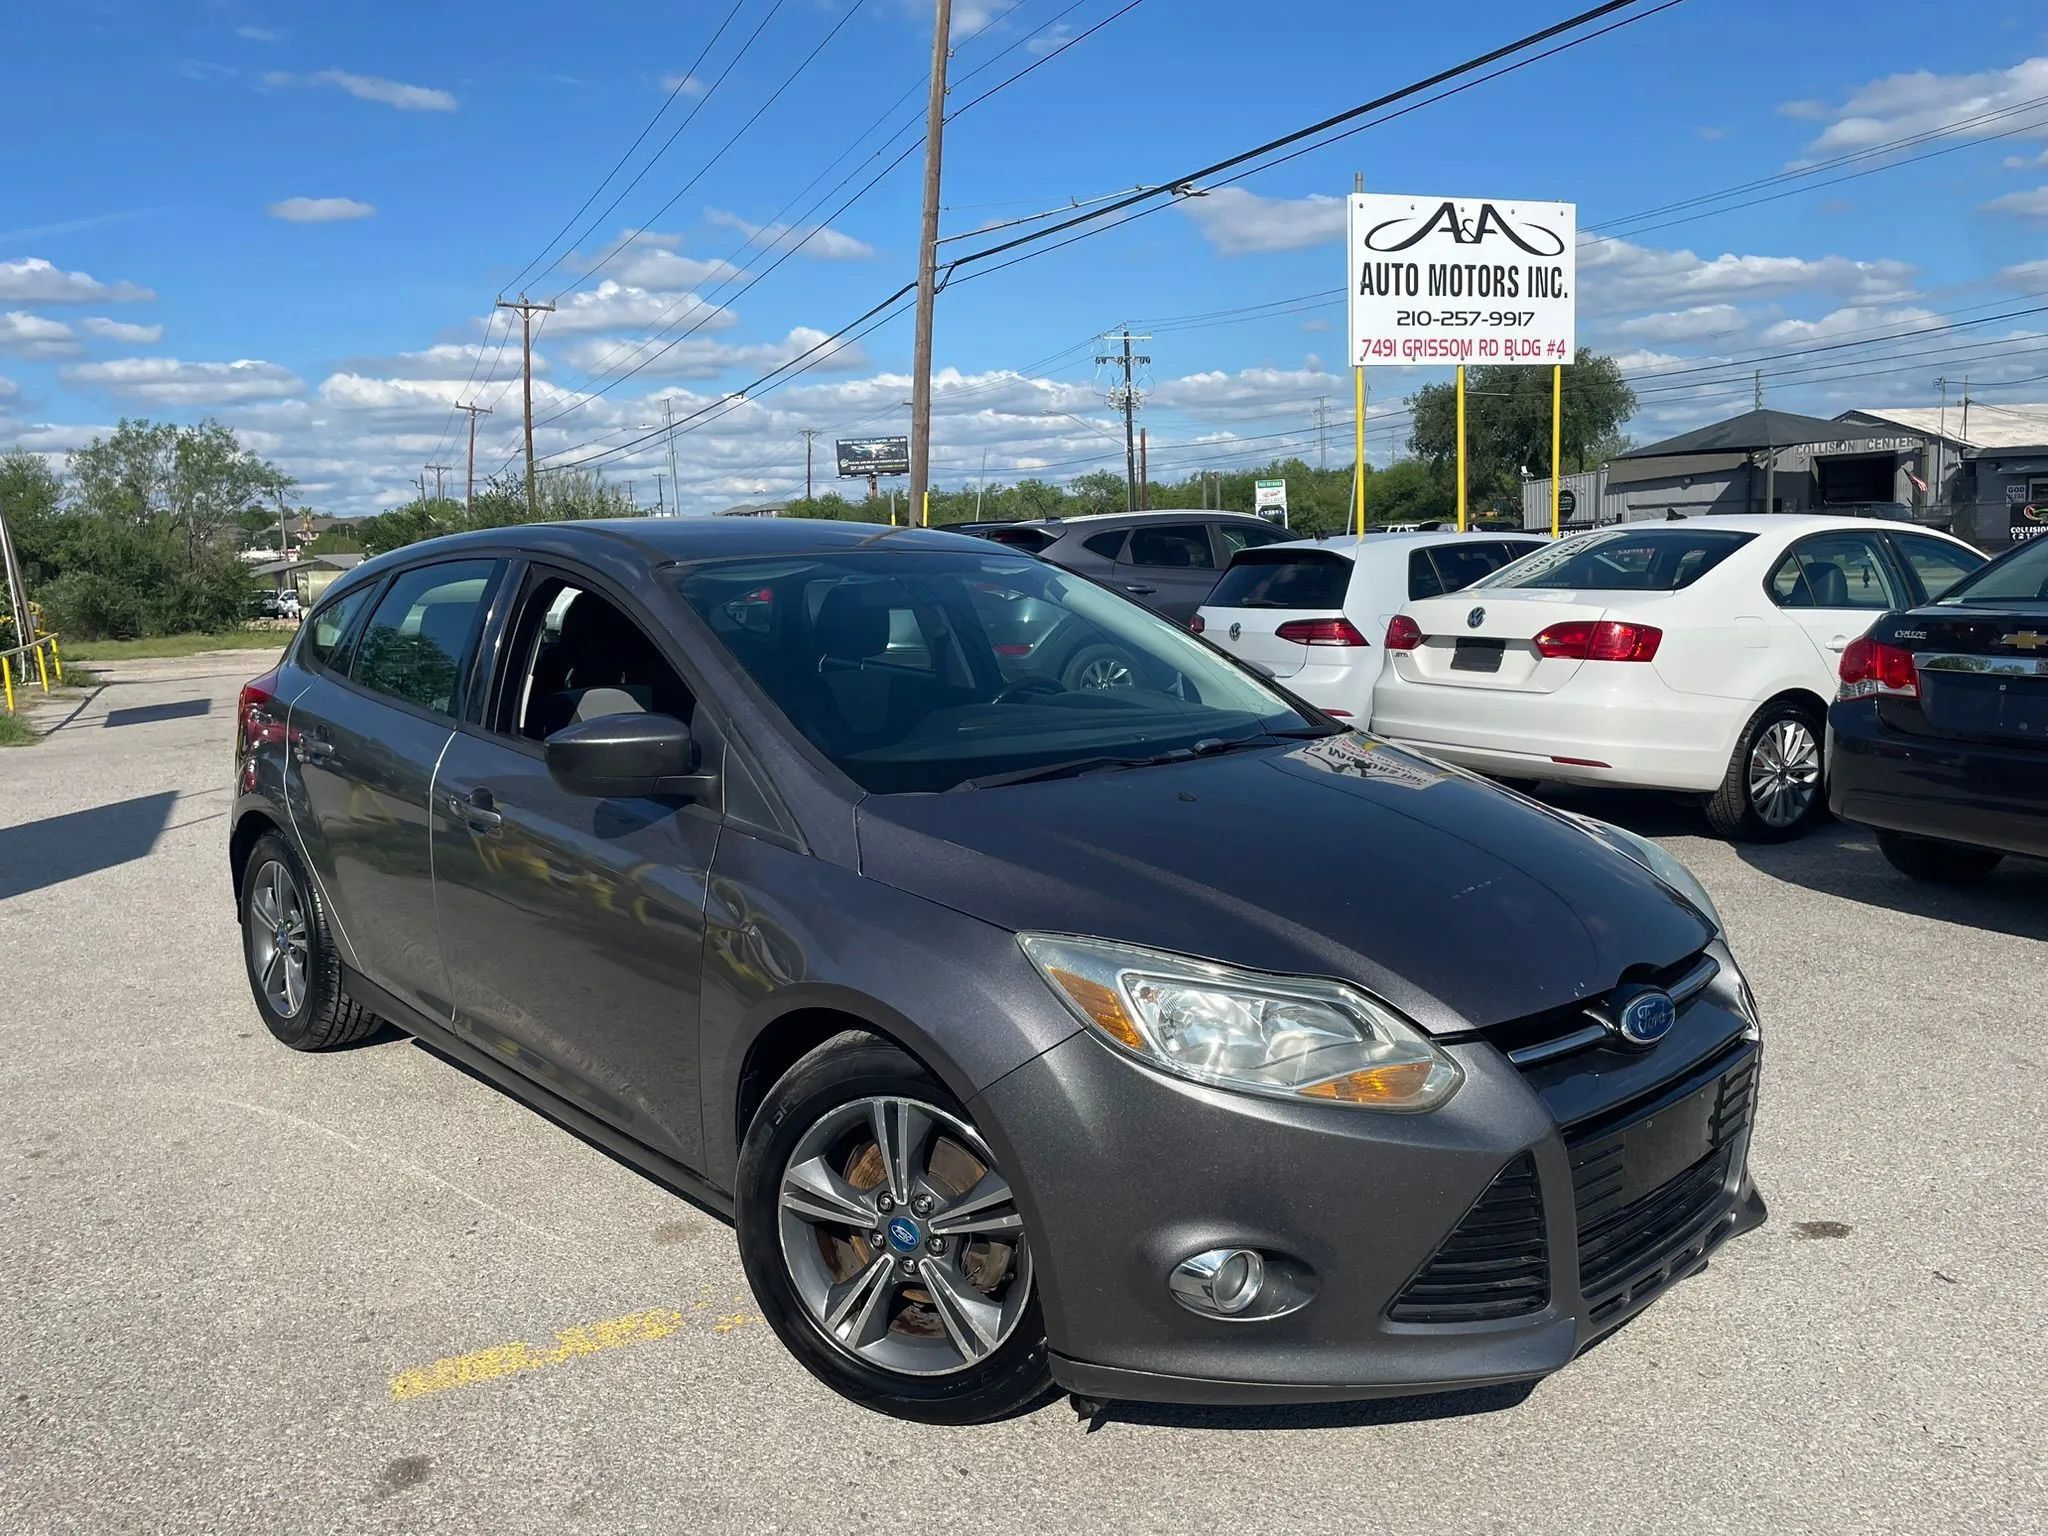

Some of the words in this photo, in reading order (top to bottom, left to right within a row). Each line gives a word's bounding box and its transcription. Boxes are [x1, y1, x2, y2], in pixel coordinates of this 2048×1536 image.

[1364, 202, 1565, 256] A&A
[1360, 262, 1419, 297] AUTO
[1428, 263, 1519, 298] MOTORS
[1527, 265, 1569, 299] INC.
[1396, 310, 1535, 327] 210-257-9917
[1361, 338, 1397, 358] 7491
[1402, 338, 1473, 358] GRISSOM
[1479, 339, 1499, 357] RD
[1504, 339, 1541, 357] BLDG
[1546, 339, 1566, 357] #4
[1796, 441, 1855, 456] COLLISION
[1866, 437, 1914, 451] CENTER
